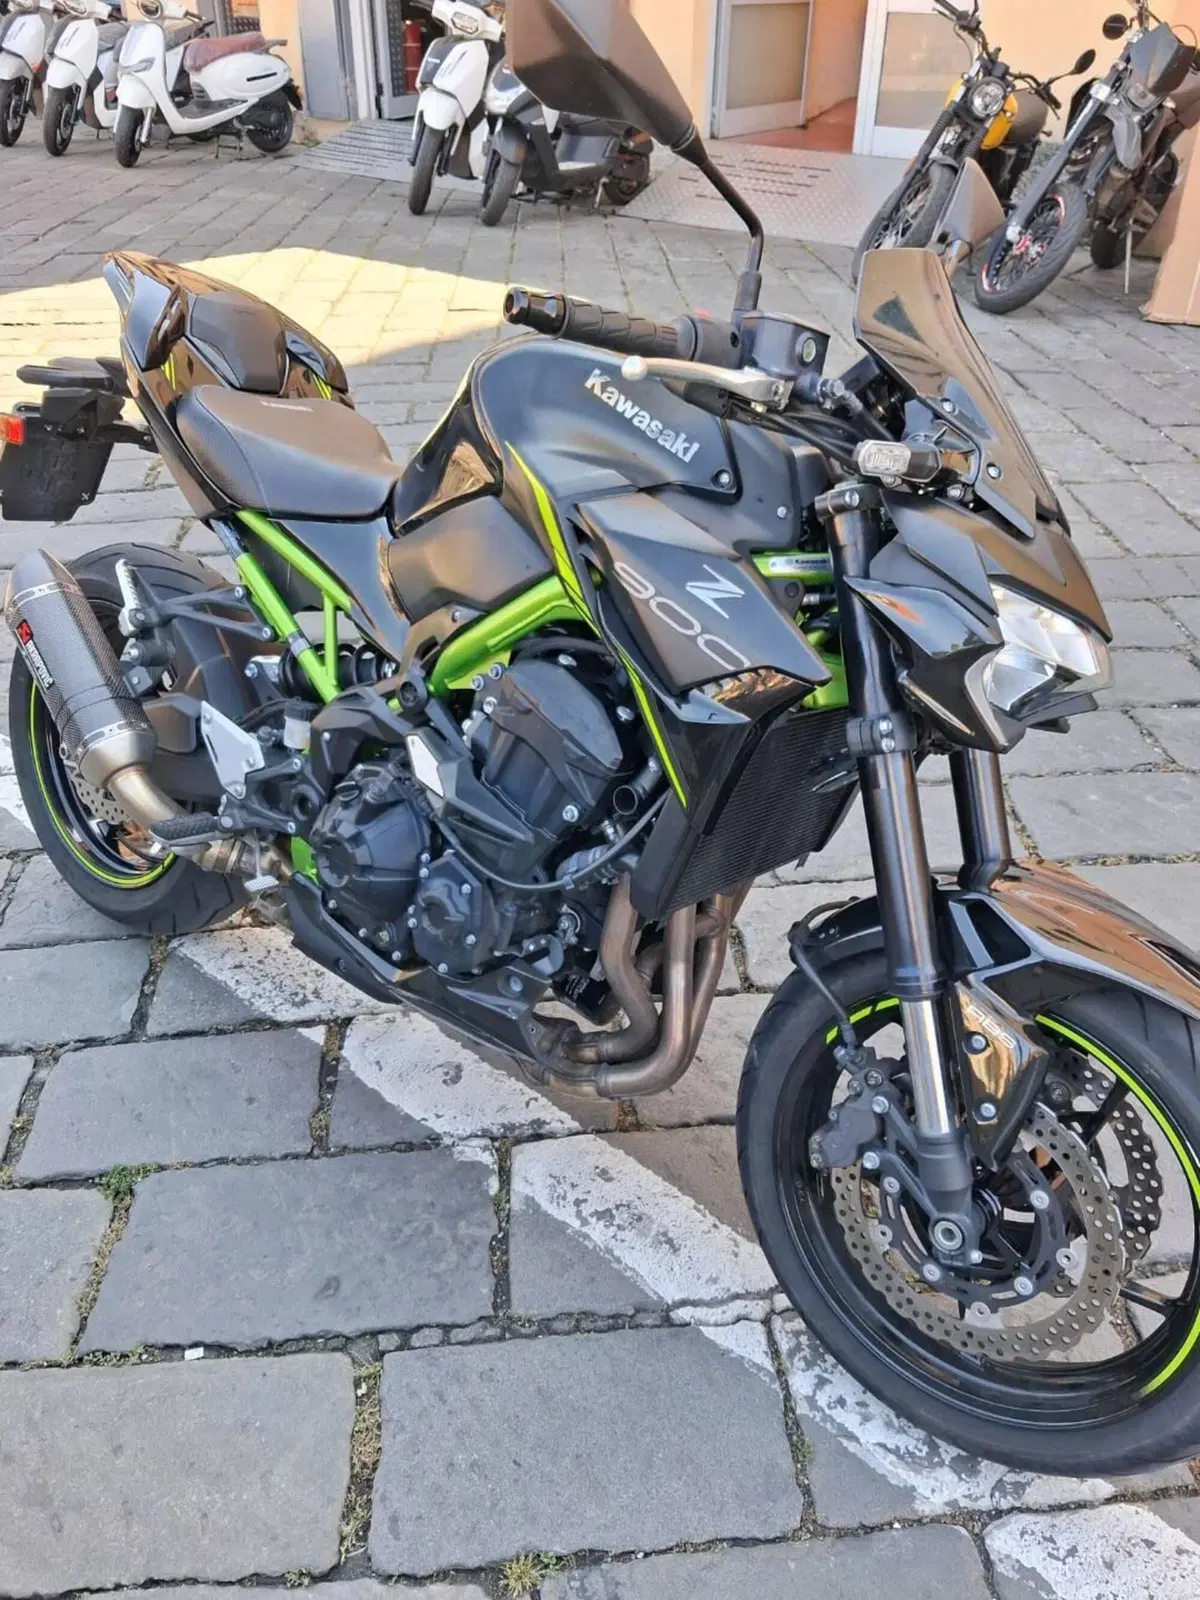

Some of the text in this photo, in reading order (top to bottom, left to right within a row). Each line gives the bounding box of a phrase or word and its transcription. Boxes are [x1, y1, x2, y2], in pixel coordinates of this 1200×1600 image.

[584, 368, 700, 463] Kawasaki
[612, 561, 751, 671] 900
[685, 564, 745, 619] Z
